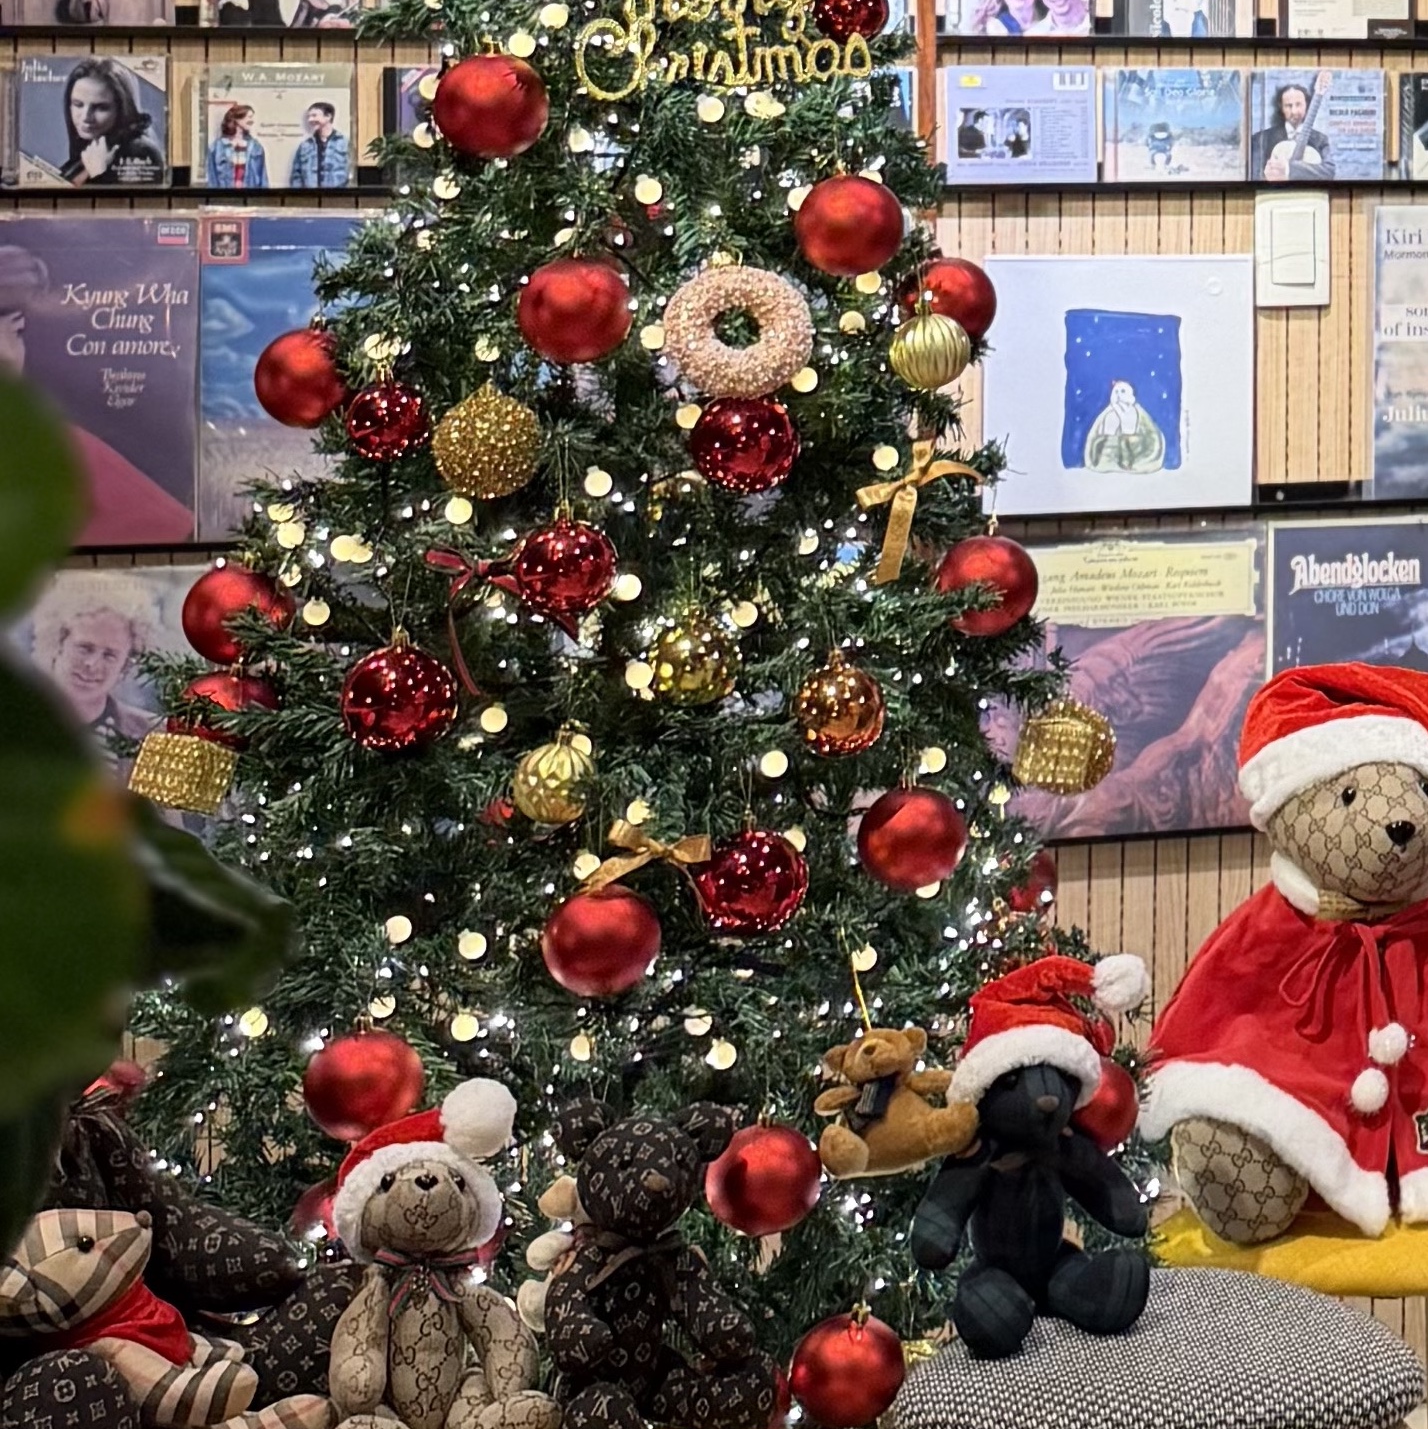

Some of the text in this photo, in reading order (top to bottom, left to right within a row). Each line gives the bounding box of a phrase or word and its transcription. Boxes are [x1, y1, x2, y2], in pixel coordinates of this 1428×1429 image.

[20, 58, 50, 75] Julia
[575, 17, 872, 101] Christmas
[23, 69, 68, 83] Fischer
[276, 73, 326, 85] MOZART
[1386, 229, 1422, 245] Kiri
[61, 283, 188, 310] Kyung Wha
[91, 307, 155, 334] Chung
[1384, 321, 1403, 337] of
[67, 333, 172, 355] Con amore
[1120, 569, 1157, 580] Mozart
[1289, 551, 1421, 596] Abendglocken
[1335, 601, 1379, 616] UND DON
